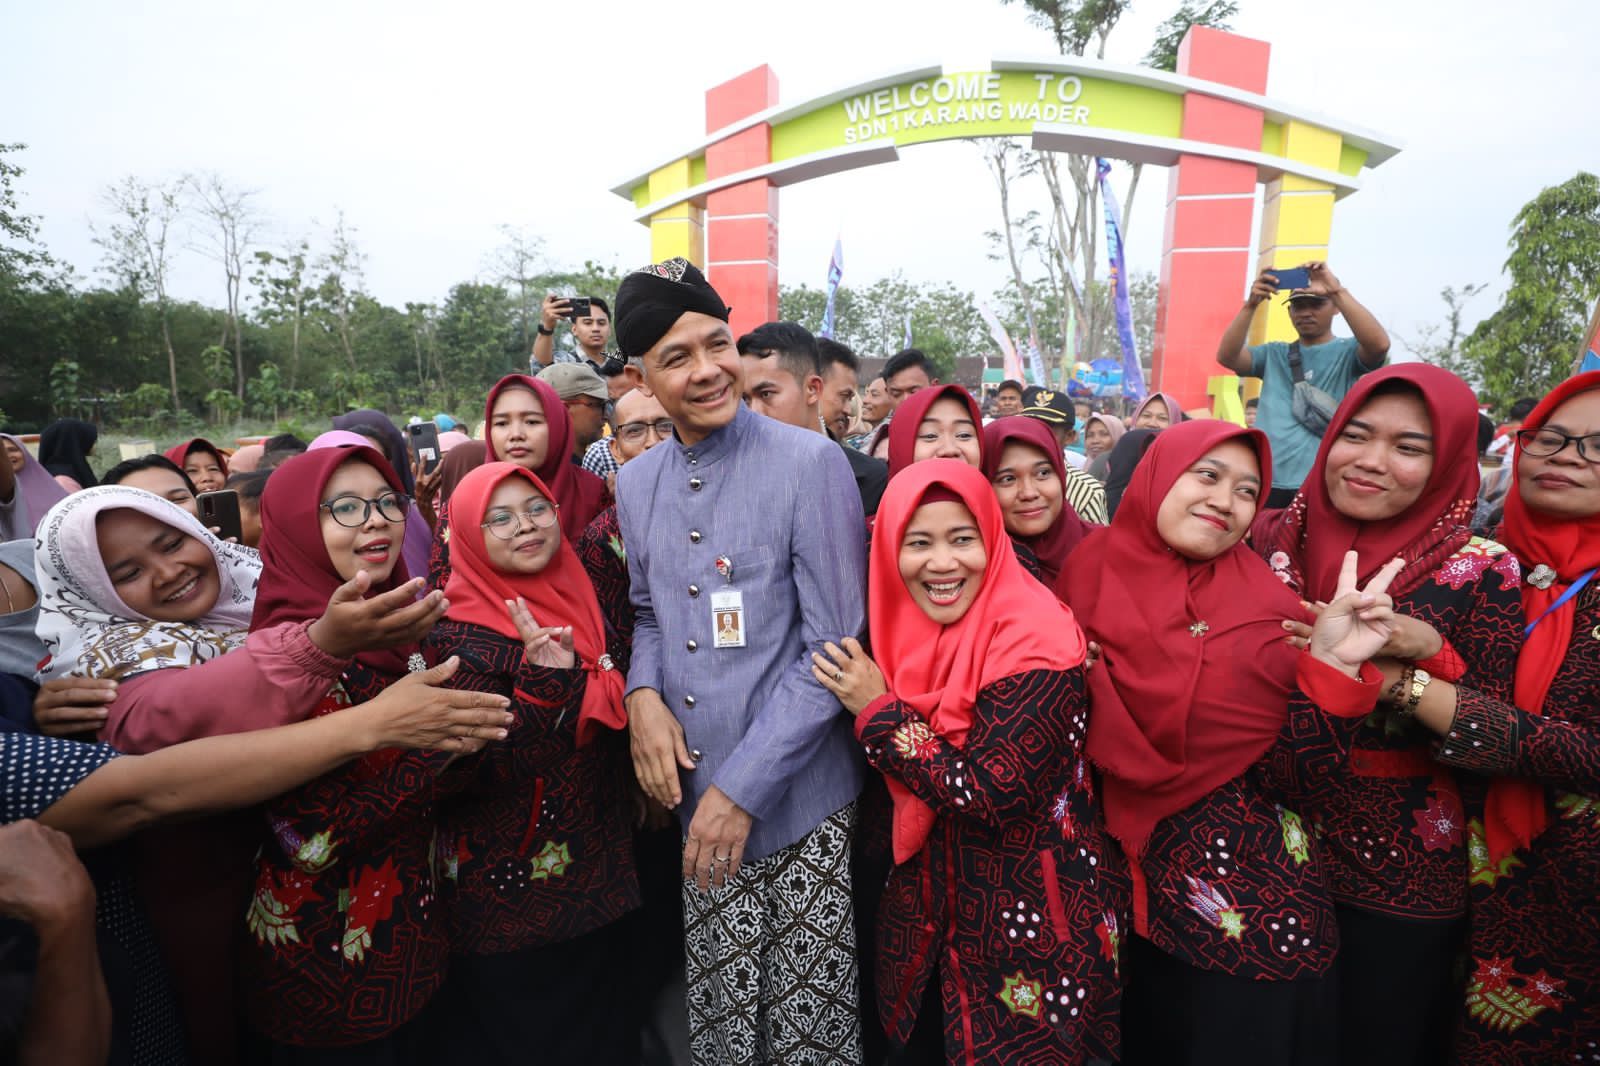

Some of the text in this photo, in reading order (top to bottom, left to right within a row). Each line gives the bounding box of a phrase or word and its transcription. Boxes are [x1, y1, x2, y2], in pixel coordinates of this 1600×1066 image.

[844, 74, 1082, 123] WELCOME TO
[845, 117, 887, 144] SDN
[903, 102, 1003, 129] KARANG
[1008, 102, 1090, 124] WADER
